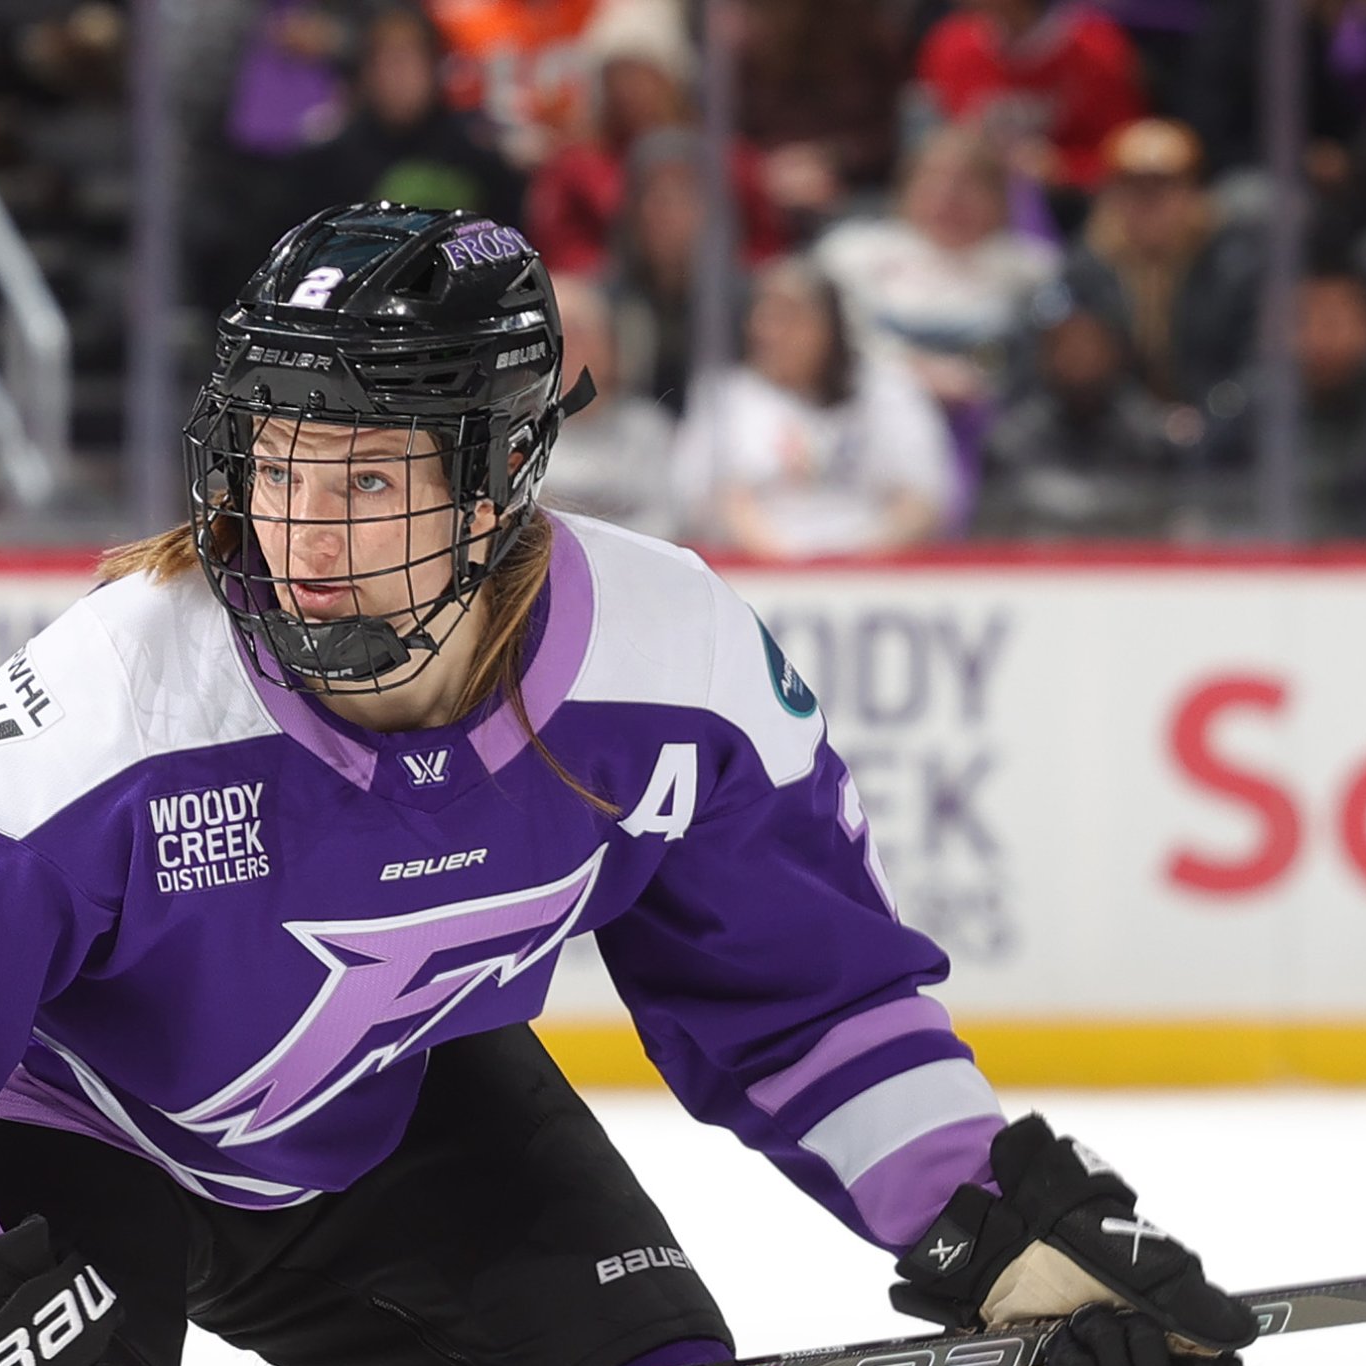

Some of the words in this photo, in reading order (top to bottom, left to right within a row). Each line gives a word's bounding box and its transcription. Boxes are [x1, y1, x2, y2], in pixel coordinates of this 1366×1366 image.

[442, 226, 532, 270] FROST
[289, 266, 344, 308] 2
[246, 345, 334, 371] BAUER
[3, 642, 61, 728] WHL
[149, 783, 264, 834] WOODY
[618, 743, 698, 842] A
[157, 820, 265, 869] CREEK
[380, 848, 488, 882] BAUER
[156, 853, 270, 893] DISTILLERS
